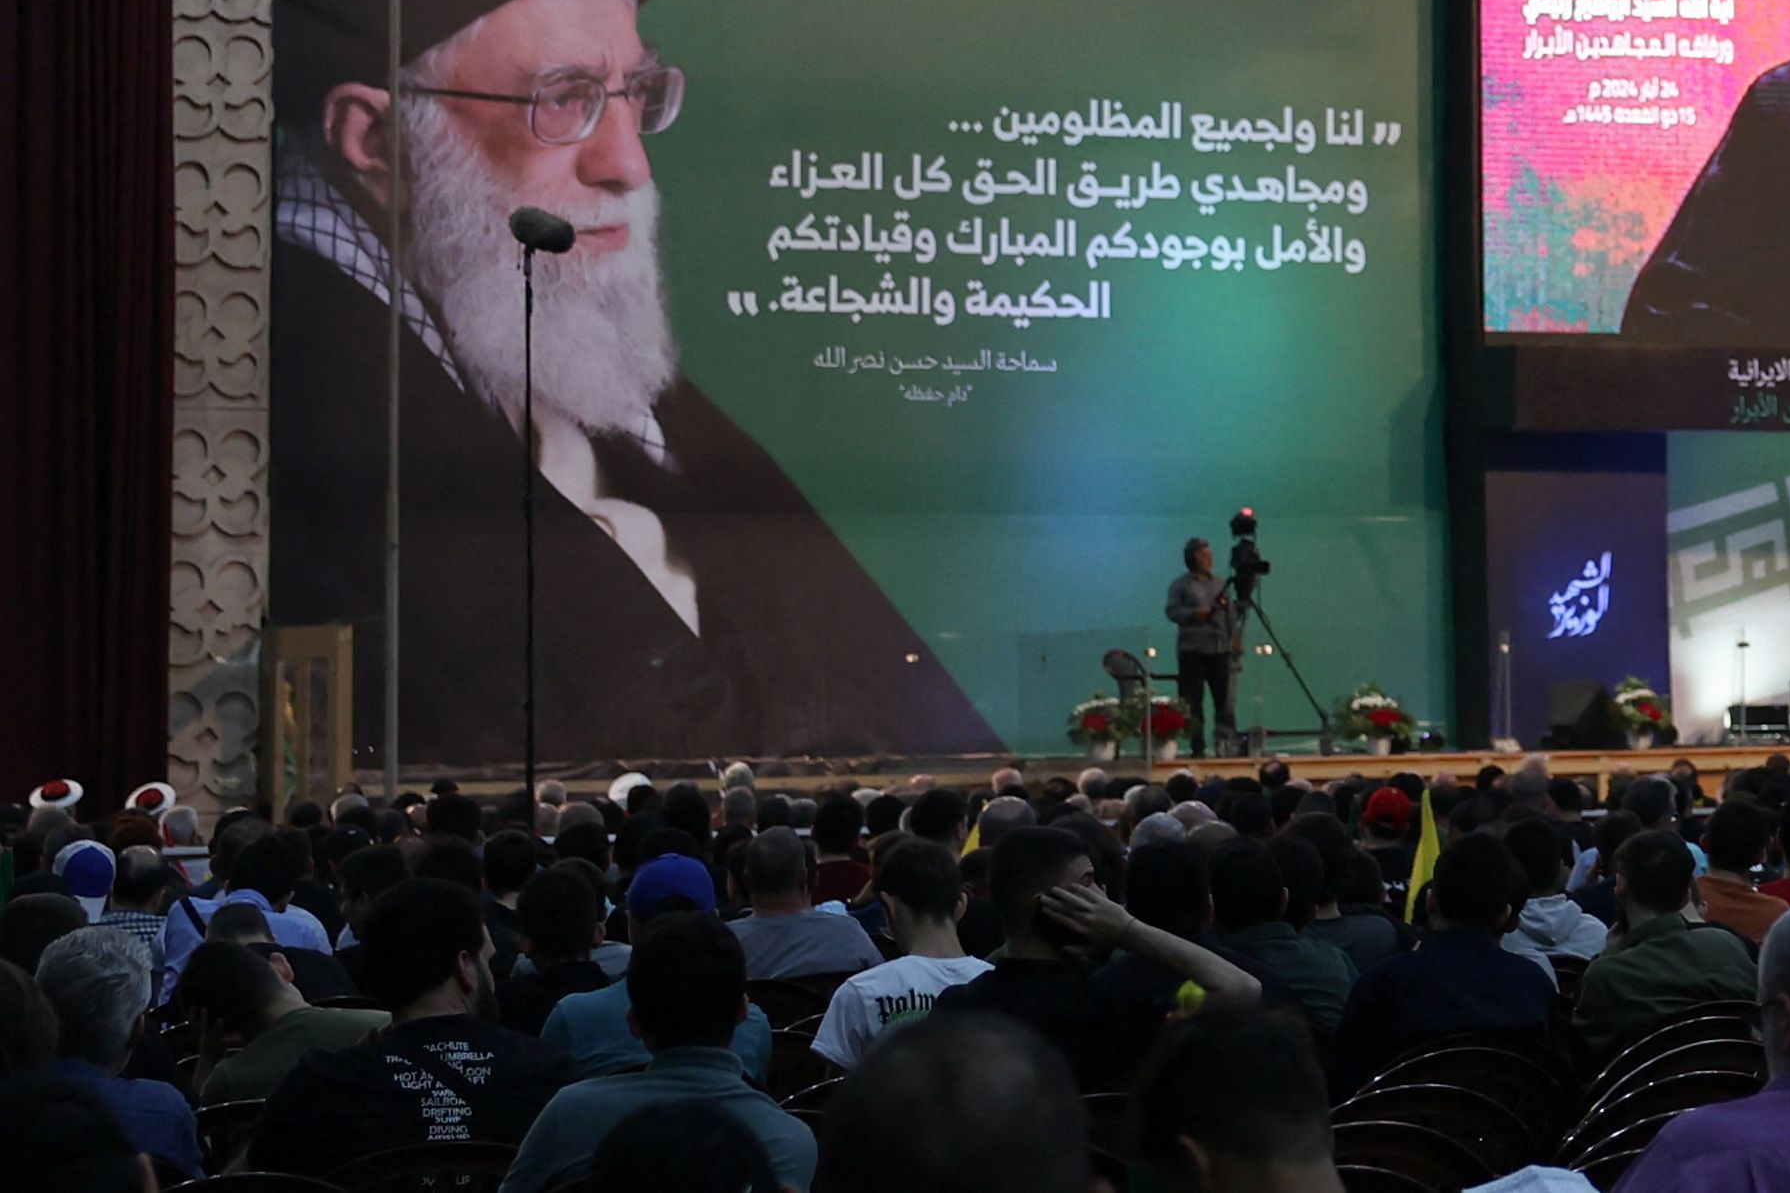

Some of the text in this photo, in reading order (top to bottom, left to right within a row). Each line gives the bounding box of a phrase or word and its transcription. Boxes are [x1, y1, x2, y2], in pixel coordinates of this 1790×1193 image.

[1523, 25, 1734, 65] ورفاقه المجاهدين الأبرار
[992, 99, 1182, 147] المظلومين
[1191, 105, 1316, 153] ولجميع
[1325, 109, 1364, 147] لنا
[769, 150, 1369, 215] ومجاهدي طريق الحق كل العزاء
[767, 211, 1367, 272] والأمل بوجودكم المبارك وقيادتكم
[964, 280, 1111, 327] الحكيمة
[813, 347, 846, 368] الله
[888, 354, 938, 375] حسن
[942, 349, 992, 375] السيد
[996, 350, 1058, 373] سماحة
[423, 1106, 472, 1118] DRIFTING
[429, 1125, 468, 1134] DIVING
